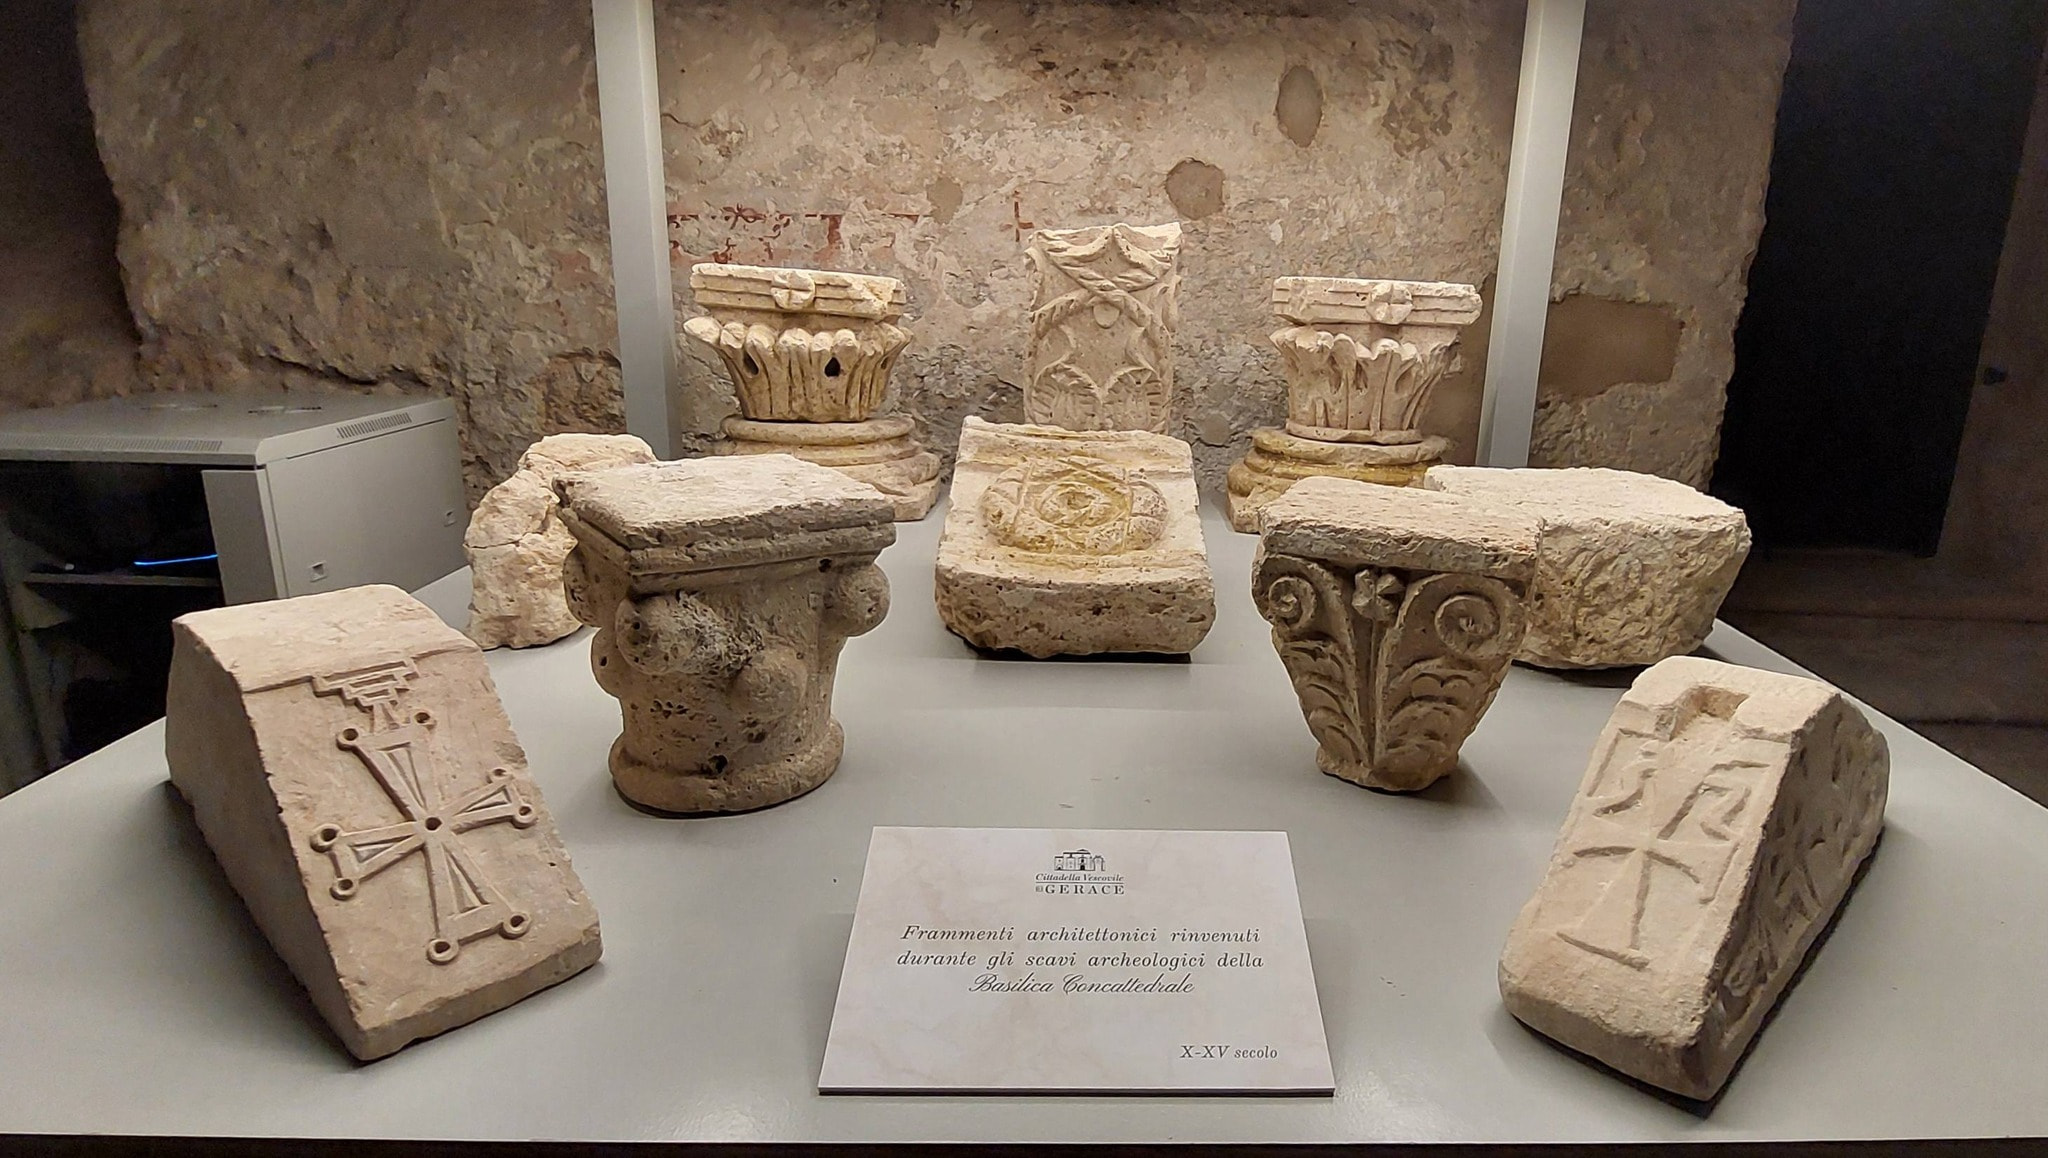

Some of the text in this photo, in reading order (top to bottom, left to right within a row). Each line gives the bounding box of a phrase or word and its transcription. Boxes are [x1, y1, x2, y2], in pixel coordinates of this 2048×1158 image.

[1035, 873, 1081, 882] Cittadella
[1045, 885, 1125, 895] GERACE
[900, 926, 1260, 943] Frammenti architettonici rinvenuti
[897, 949, 1263, 972] durante gli scavi archeologici della
[969, 972, 1195, 995] Basilica Concattedrale
[1180, 1046, 1278, 1059] X-XV secolo
